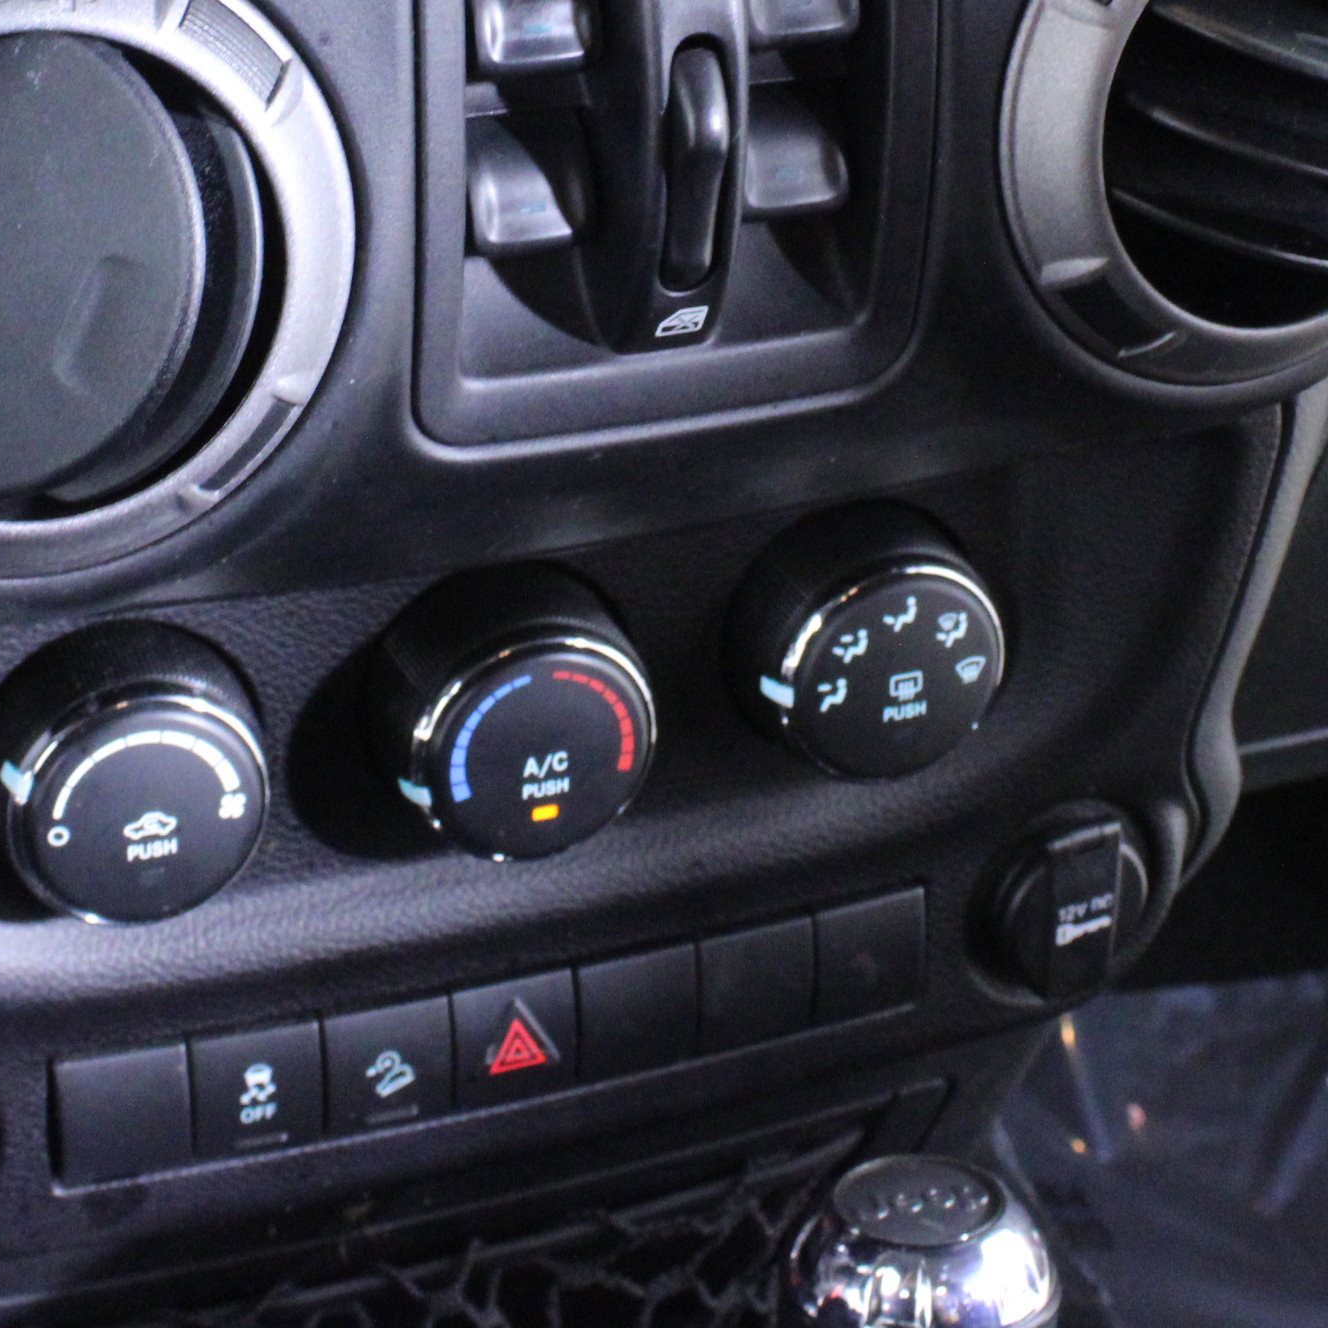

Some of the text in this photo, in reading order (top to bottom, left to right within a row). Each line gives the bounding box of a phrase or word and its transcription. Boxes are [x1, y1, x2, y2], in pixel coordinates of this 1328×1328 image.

[882, 700, 928, 723] PUSH
[522, 750, 570, 781] A/C
[521, 775, 571, 802] PUSH
[126, 836, 179, 863] PUSH
[239, 1102, 278, 1125] OFF
